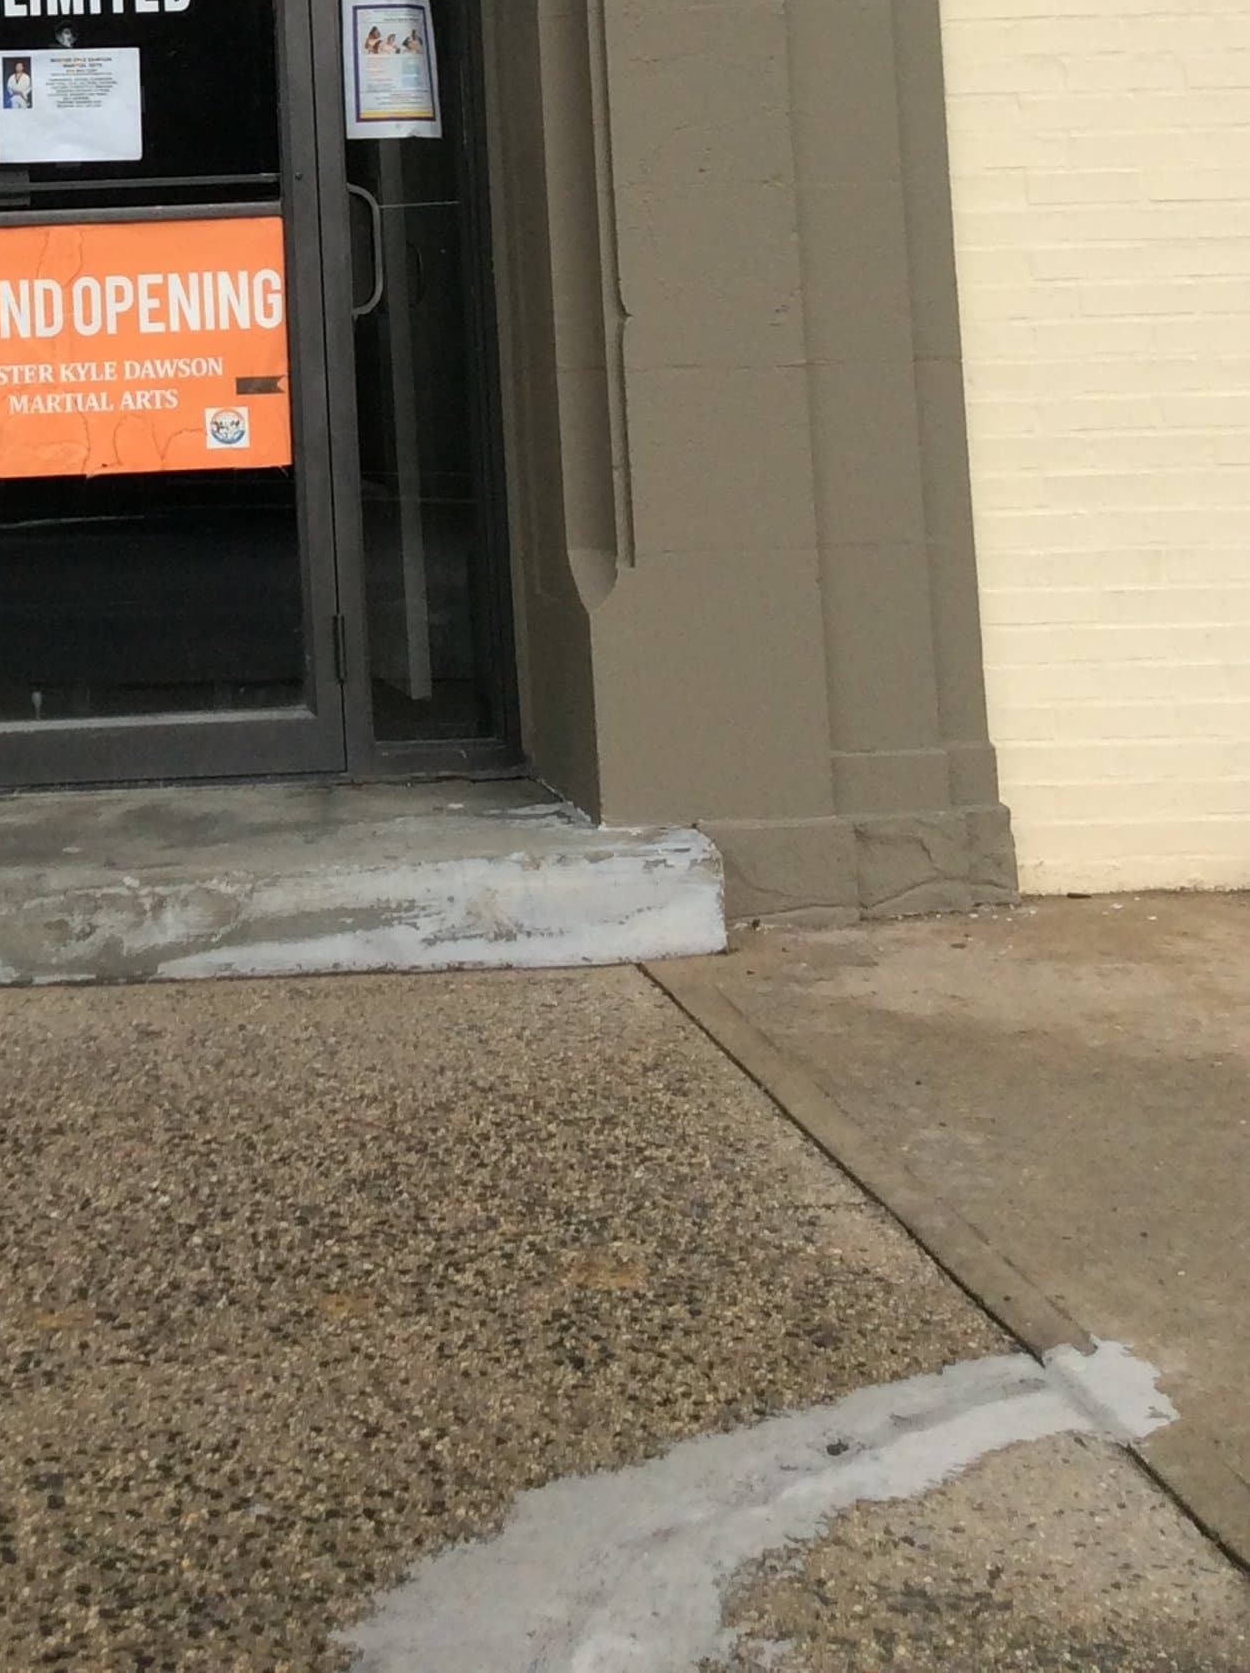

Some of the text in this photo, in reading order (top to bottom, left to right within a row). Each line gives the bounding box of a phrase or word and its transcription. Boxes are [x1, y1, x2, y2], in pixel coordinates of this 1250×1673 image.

[72, 268, 283, 337] OPENING
[59, 361, 117, 383] KYLE
[124, 357, 224, 379] DAWSON
[8, 389, 179, 415] MARTIAL ARTS
